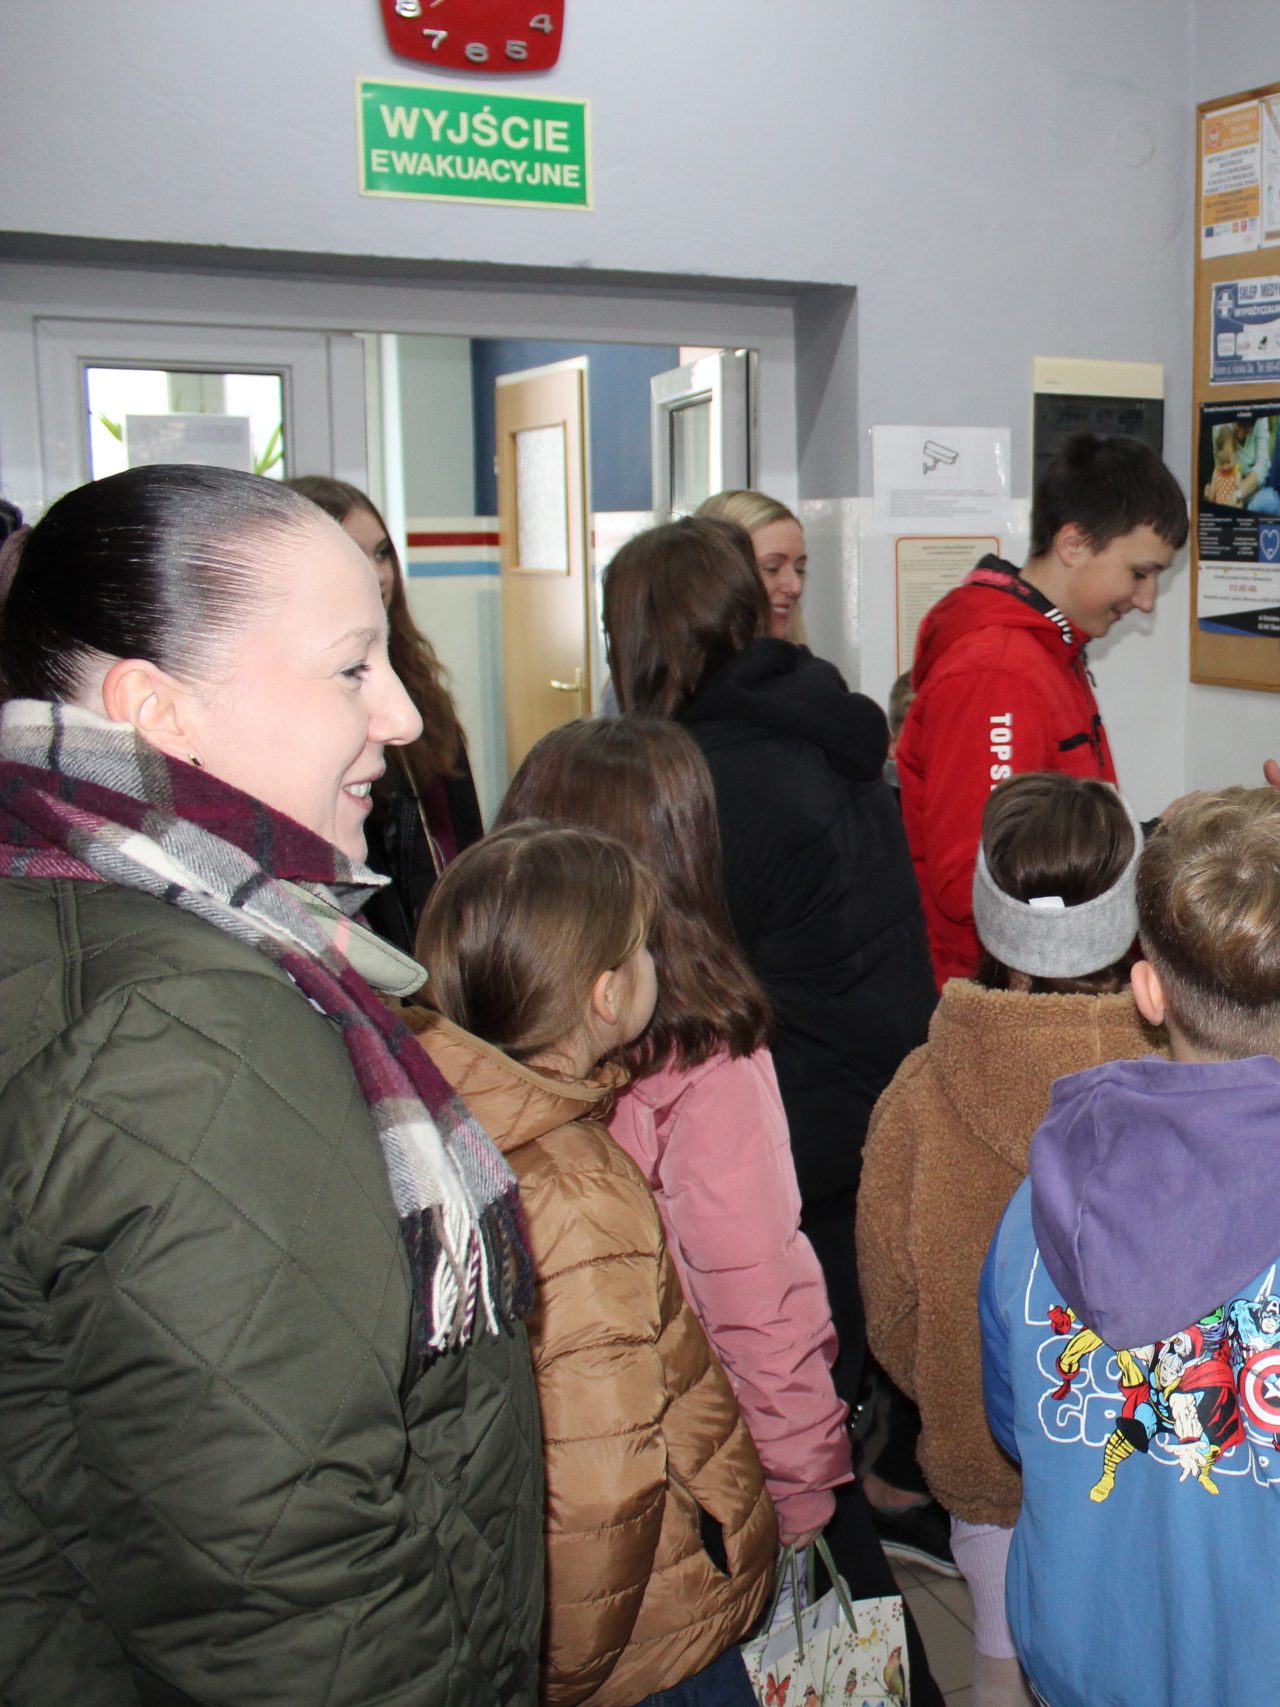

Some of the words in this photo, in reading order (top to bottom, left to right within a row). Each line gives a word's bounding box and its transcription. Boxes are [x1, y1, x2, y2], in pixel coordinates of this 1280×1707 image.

[529, 14, 553, 34] 4
[422, 29, 448, 50] 7
[505, 40, 528, 60] 5
[464, 42, 489, 62] 6
[379, 105, 570, 153] WYJŚCIE
[371, 149, 580, 188] EWAKUACYJNE
[989, 712, 1012, 791] TOPS
